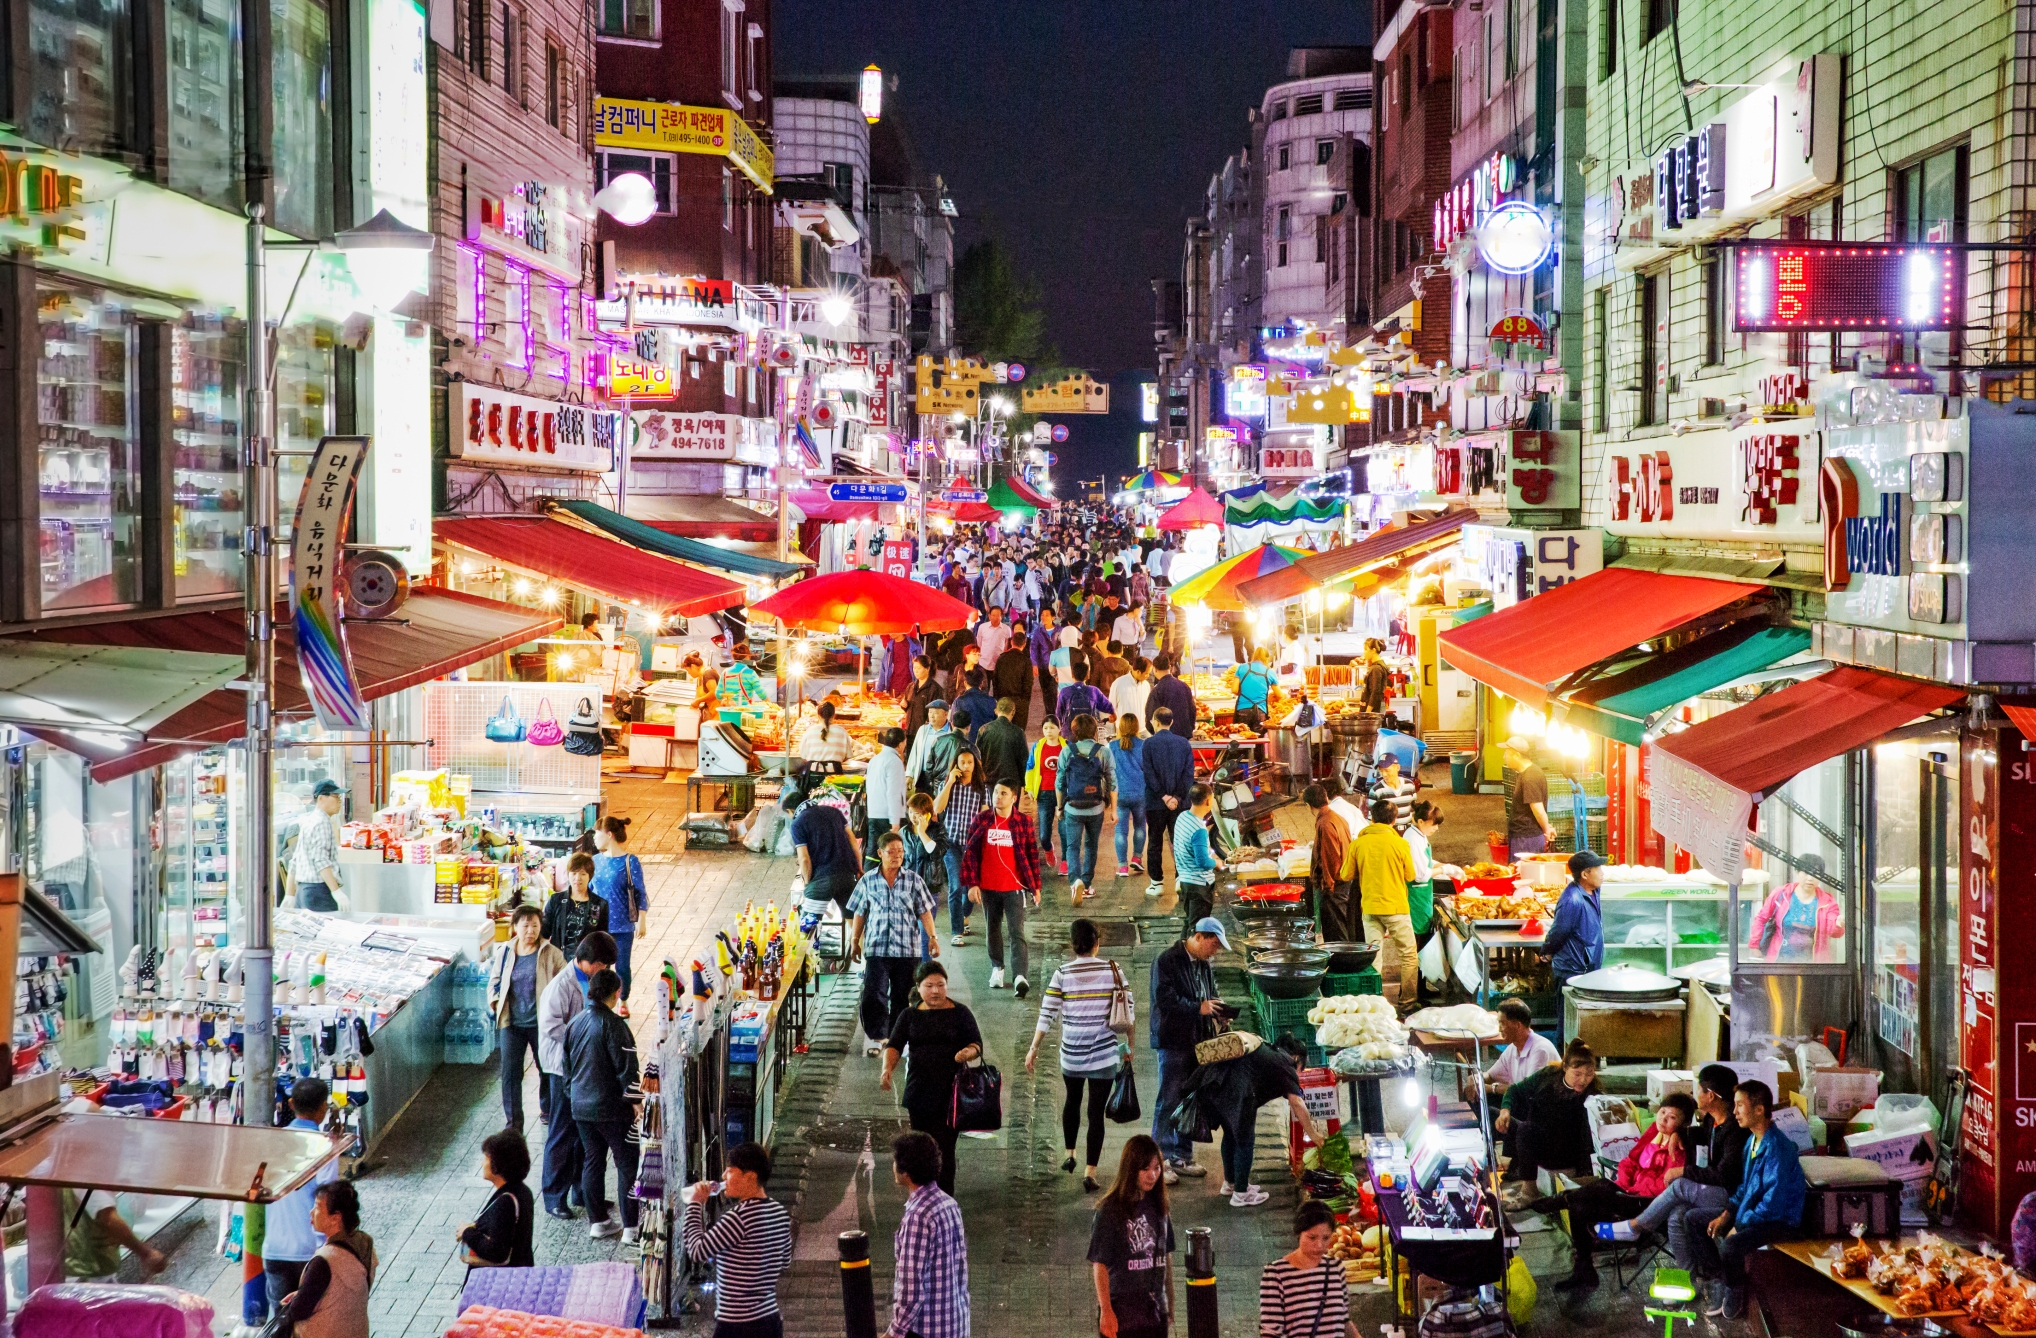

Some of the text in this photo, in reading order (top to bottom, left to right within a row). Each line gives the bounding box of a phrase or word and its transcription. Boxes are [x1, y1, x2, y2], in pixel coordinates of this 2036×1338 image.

[660, 108, 688, 130] 근로자
[689, 111, 724, 133] 파견업체
[661, 283, 726, 309] HANA
[1503, 317, 1528, 332] 88
[1350, 411, 1369, 421] 中国
[671, 418, 726, 435] 정육/야채
[671, 437, 726, 451] 494-7618
[305, 454, 348, 601] 다문화 음식거리
